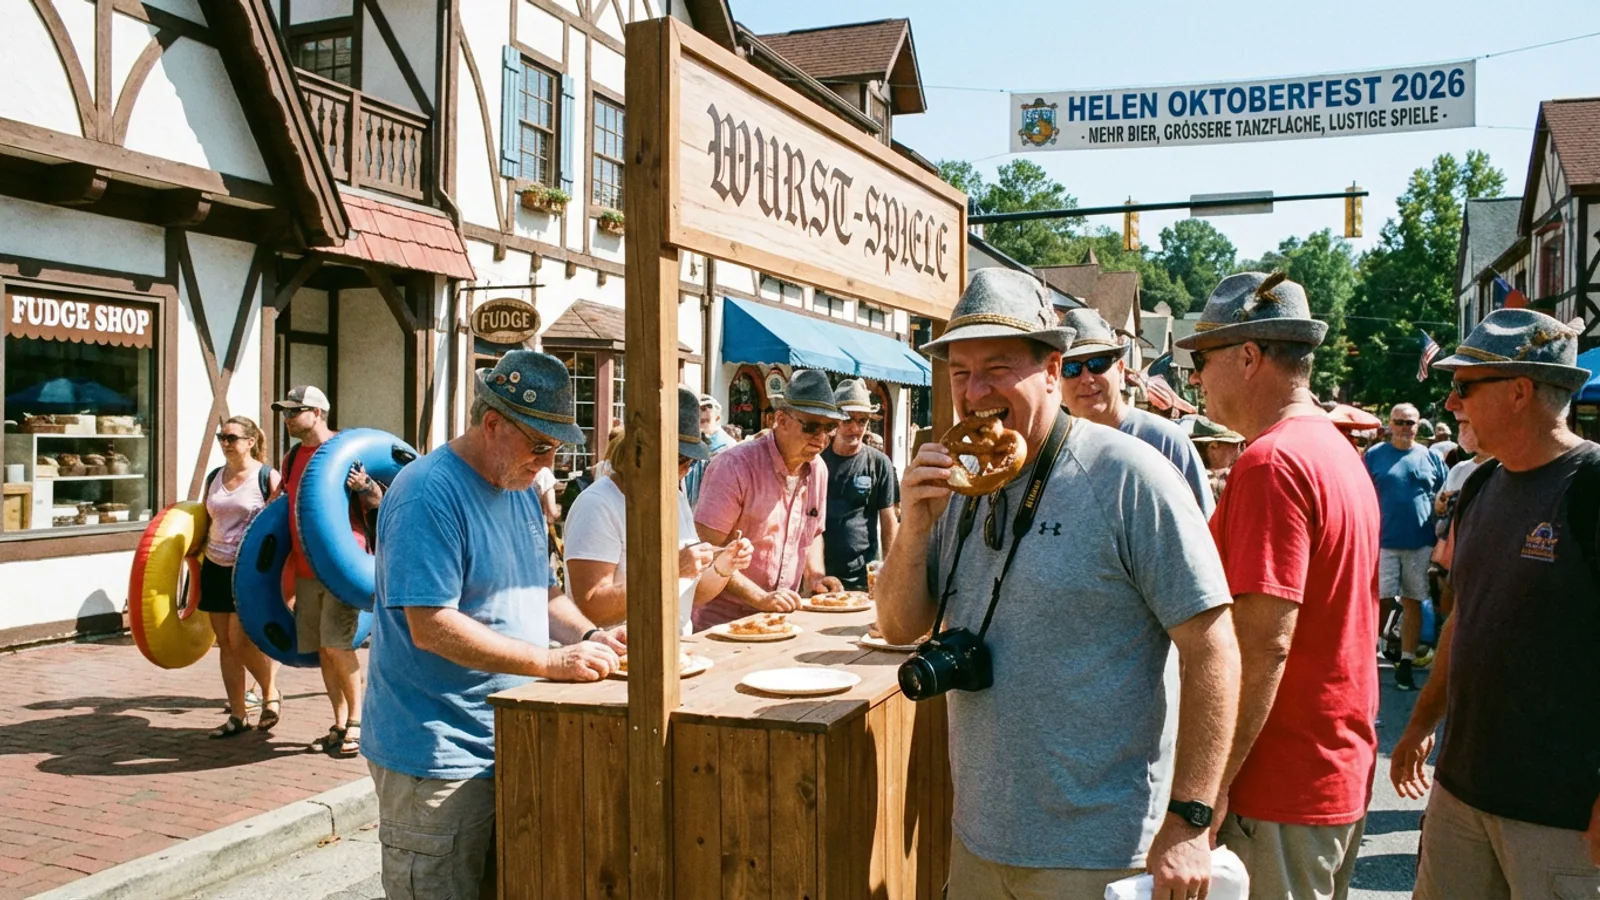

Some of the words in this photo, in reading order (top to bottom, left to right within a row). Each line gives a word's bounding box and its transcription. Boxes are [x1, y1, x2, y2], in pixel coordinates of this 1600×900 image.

[1068, 92, 1158, 122] HELEN
[1168, 76, 1382, 118] OKTOBERFEST
[1391, 68, 1465, 103] 2026
[1128, 124, 1160, 144] BIER,
[1329, 110, 1387, 131] LUSTIGE
[1391, 106, 1439, 127] SPIELE
[706, 102, 949, 283] WURST-SPIELE
[12, 295, 90, 330] FUDGE
[94, 305, 150, 335] SHOP
[480, 311, 530, 330] FUDGE
